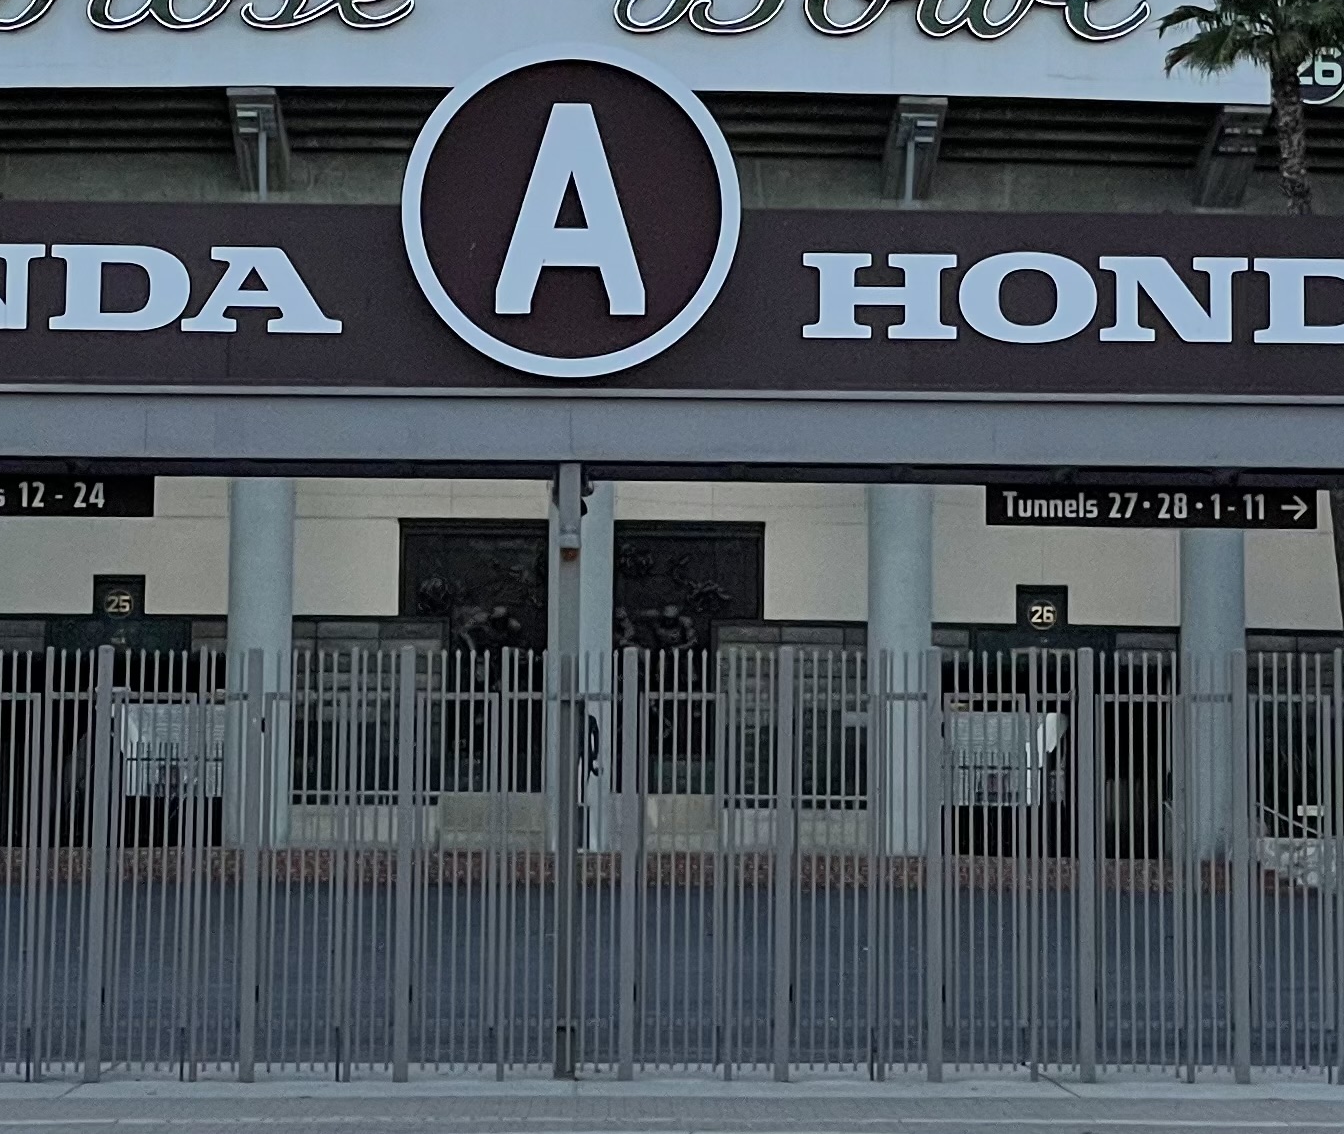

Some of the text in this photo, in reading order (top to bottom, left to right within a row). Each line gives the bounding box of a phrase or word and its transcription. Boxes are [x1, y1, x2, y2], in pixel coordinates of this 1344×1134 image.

[495, 102, 646, 316] A
[19, 481, 45, 508] 12
[73, 481, 106, 509] 24
[1003, 490, 1098, 518] Tunnels
[107, 594, 131, 613] 25
[1030, 605, 1054, 623] 26
